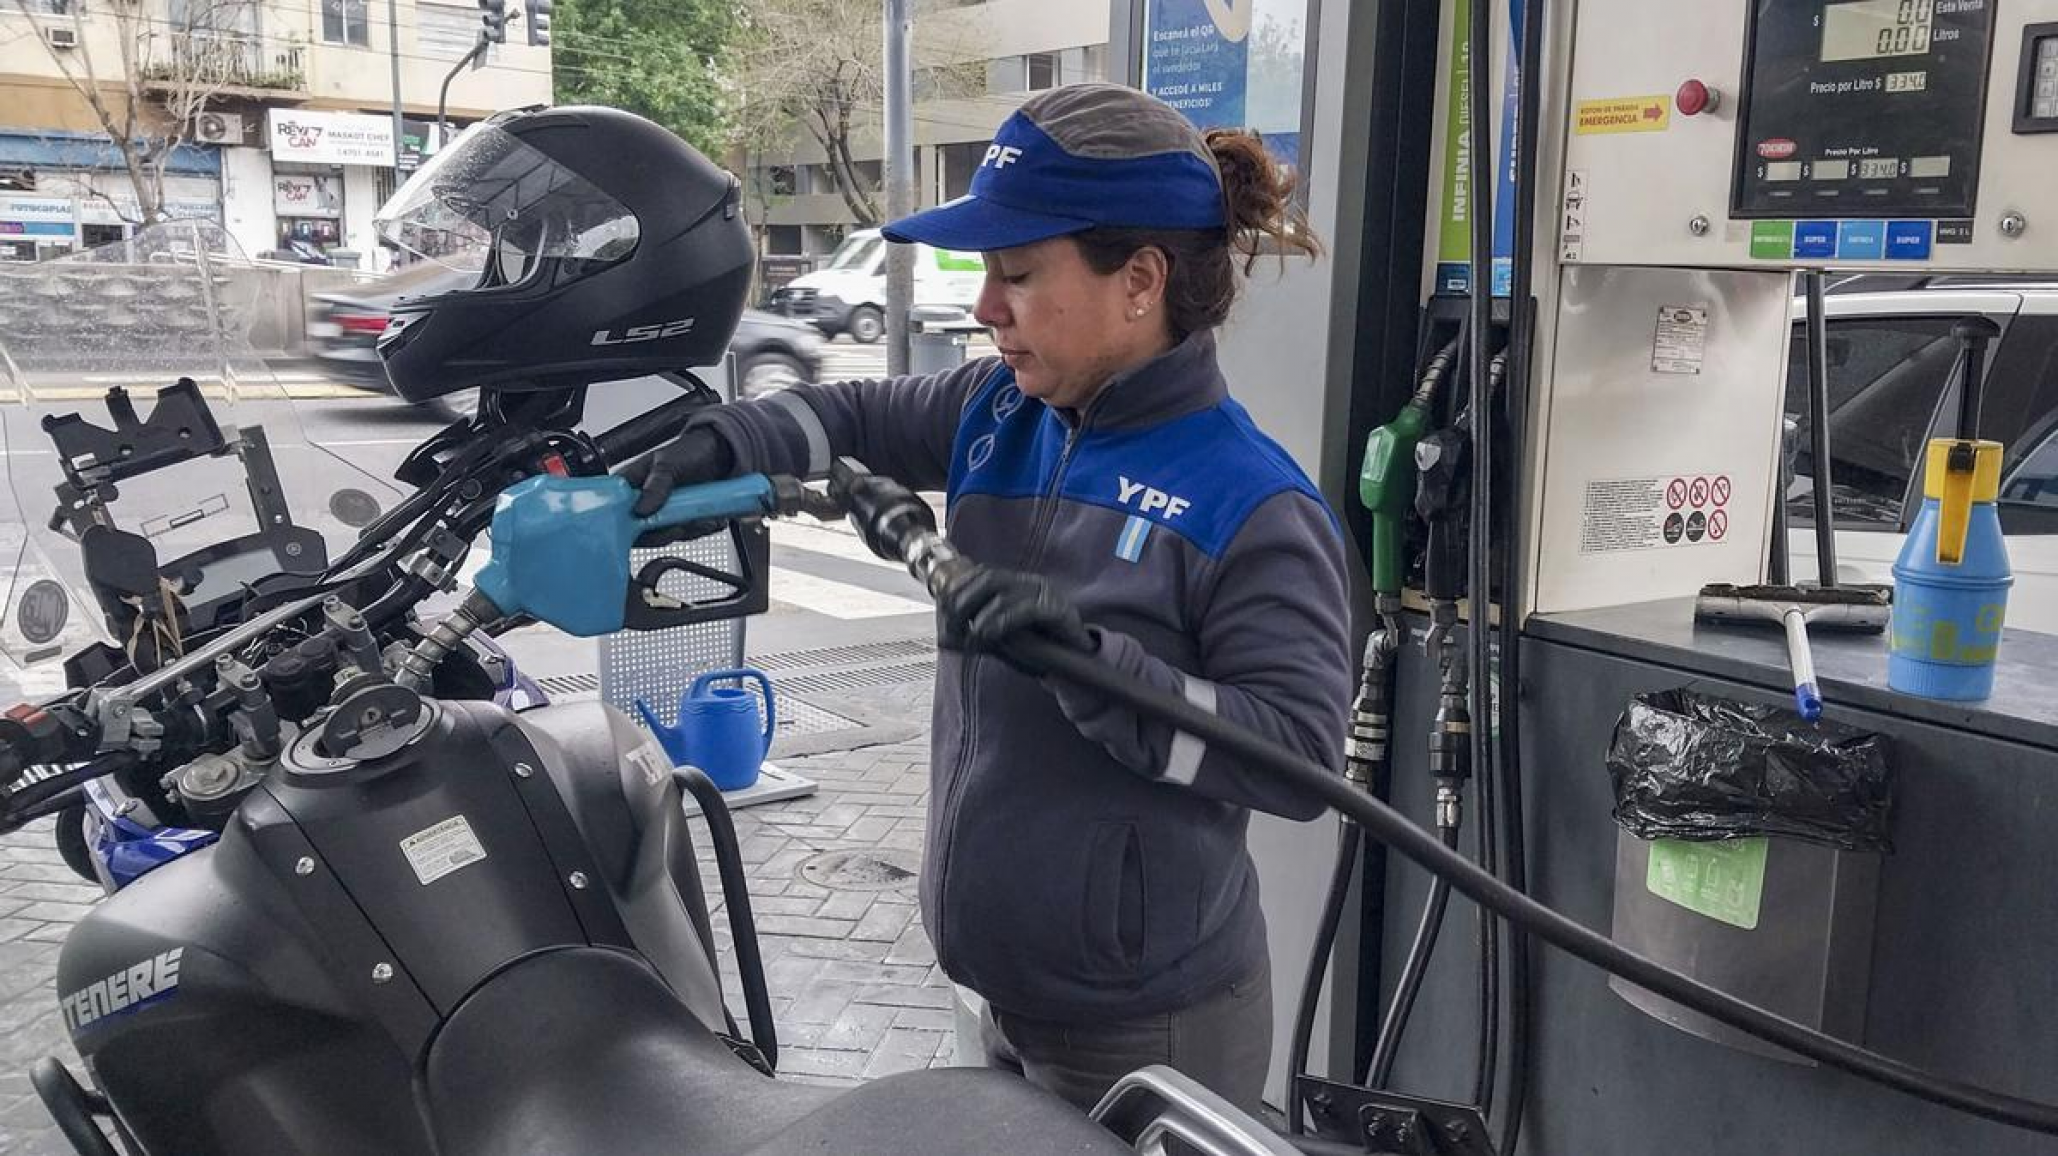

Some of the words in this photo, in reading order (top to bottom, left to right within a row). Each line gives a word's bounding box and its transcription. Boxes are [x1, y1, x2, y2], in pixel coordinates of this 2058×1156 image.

[1935, 1, 1957, 14] Esta
[1958, 0, 1983, 12] Venta
[1813, 15, 1820, 27] $
[1932, 29, 1959, 41] Litros
[1810, 82, 1836, 94] Precio
[1838, 82, 1852, 95] por
[1853, 78, 1873, 91] Litro
[1875, 77, 1882, 90] $
[1579, 114, 1638, 127] EMERGENCIA
[982, 144, 1022, 168] PF
[1825, 148, 1847, 156] Precio
[1848, 147, 1861, 155] Por
[1453, 130, 1470, 221] INFINIA
[1757, 167, 1764, 178] $
[1804, 165, 1810, 176] $
[1851, 164, 1857, 175] $
[1901, 163, 1907, 174] $
[590, 319, 694, 345] LS2
[1117, 475, 1190, 518] YPF
